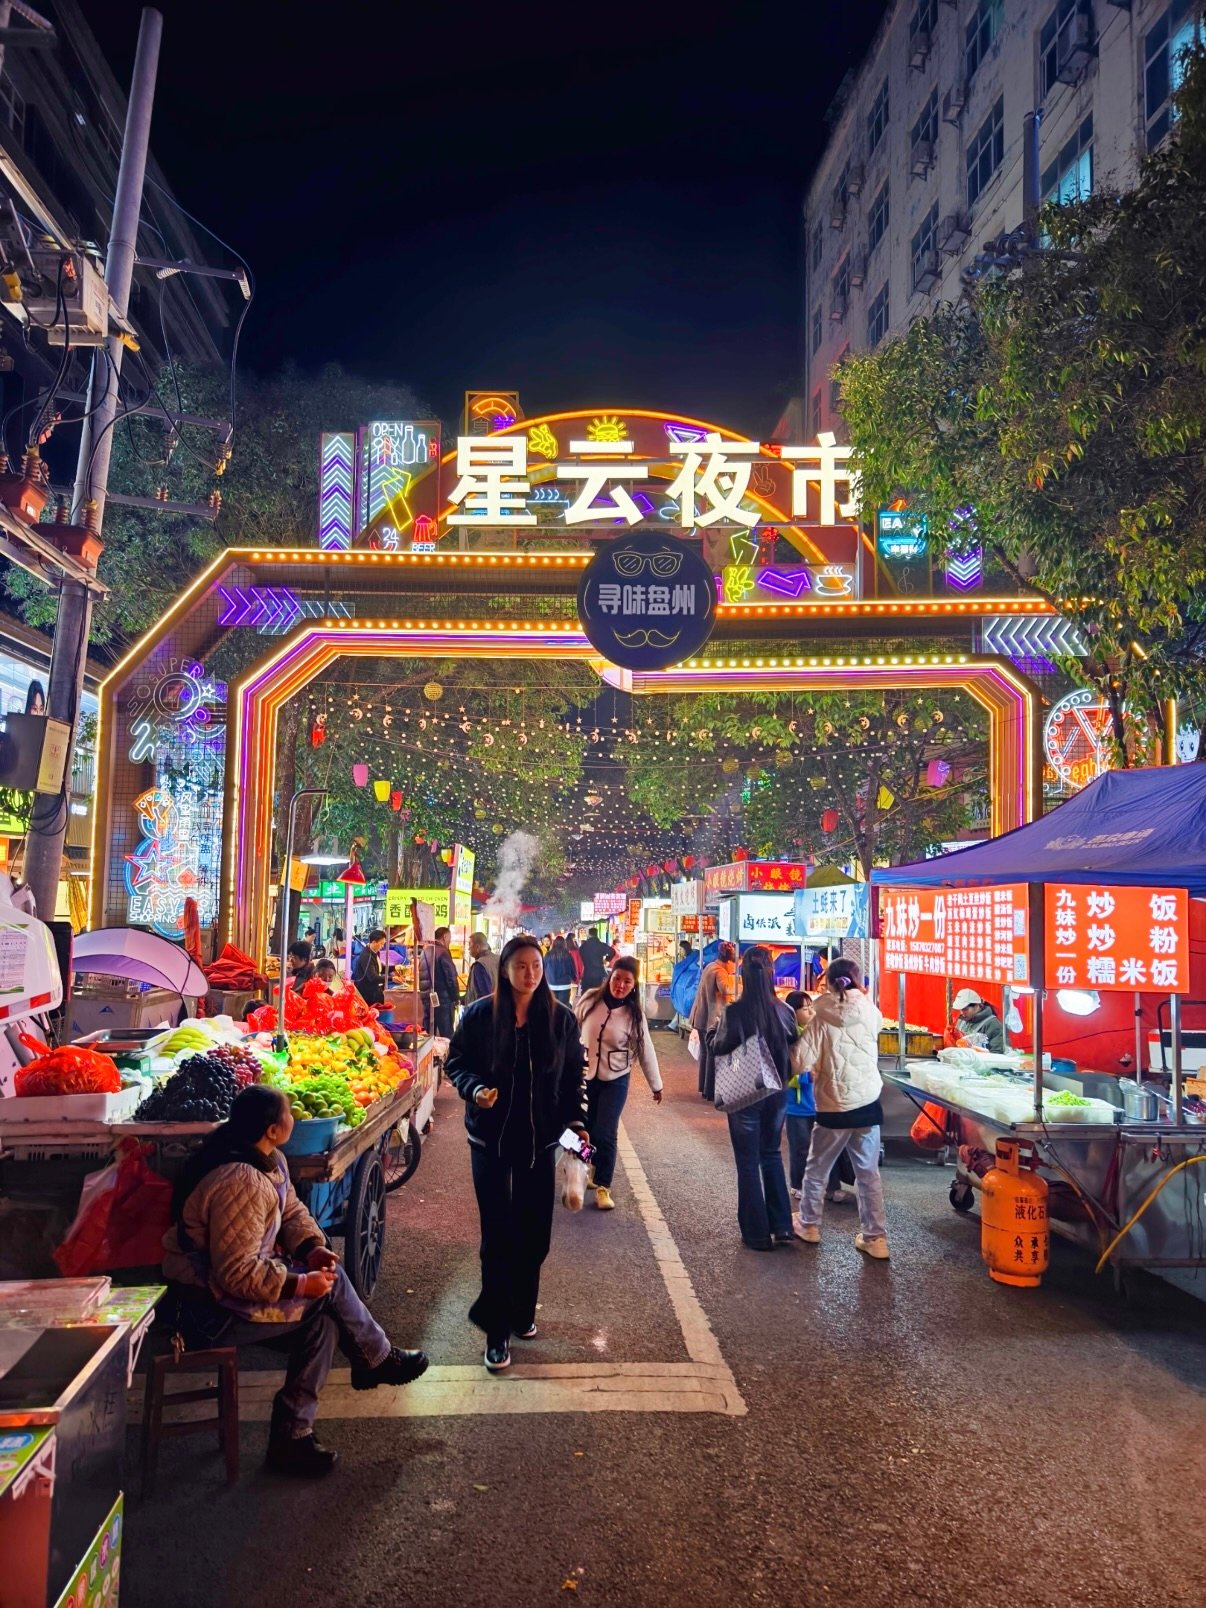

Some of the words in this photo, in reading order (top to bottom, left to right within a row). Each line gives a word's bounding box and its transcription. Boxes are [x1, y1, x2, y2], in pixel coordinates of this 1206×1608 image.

[373, 423, 403, 437] OPEN
[446, 432, 862, 528] 星云夜市
[383, 527, 399, 541] 24
[598, 584, 695, 616] 寻味盘州
[750, 866, 803, 881] 小眼镜
[129, 911, 177, 924] SHOPPING
[130, 895, 182, 913] EASY
[886, 895, 946, 940] 九妹炒一份
[1087, 891, 1178, 921] 炒饭
[1056, 889, 1077, 984] 九妹炒一份
[1087, 924, 1178, 953] 炒粉
[1087, 956, 1178, 986] 糯米饭
